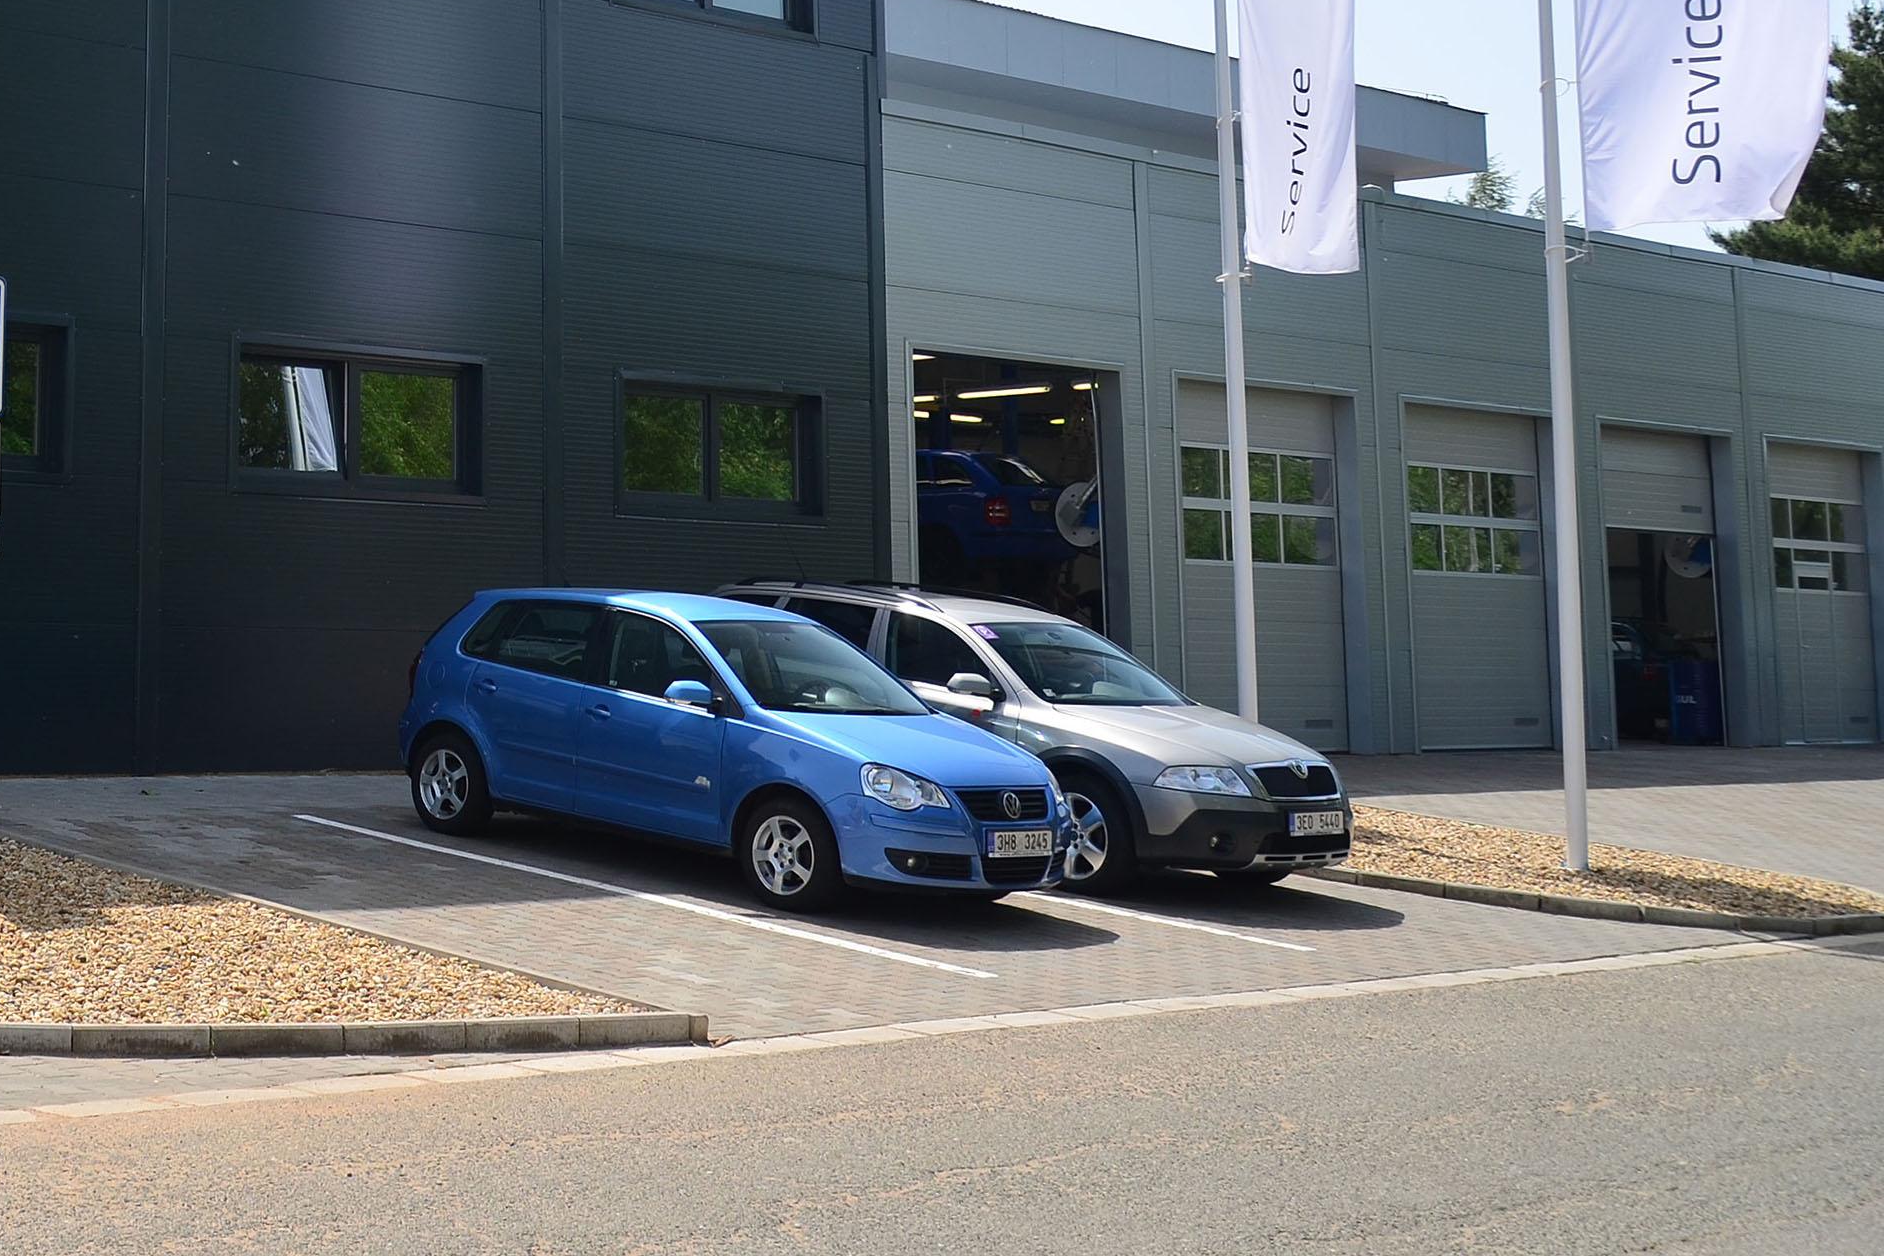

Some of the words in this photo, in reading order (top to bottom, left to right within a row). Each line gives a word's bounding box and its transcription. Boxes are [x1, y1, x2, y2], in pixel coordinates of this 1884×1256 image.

[1281, 67, 1311, 237] Service
[1319, 813, 1340, 829] 5440
[997, 833, 1017, 851] 3H8
[1025, 832, 1048, 850] 3245
